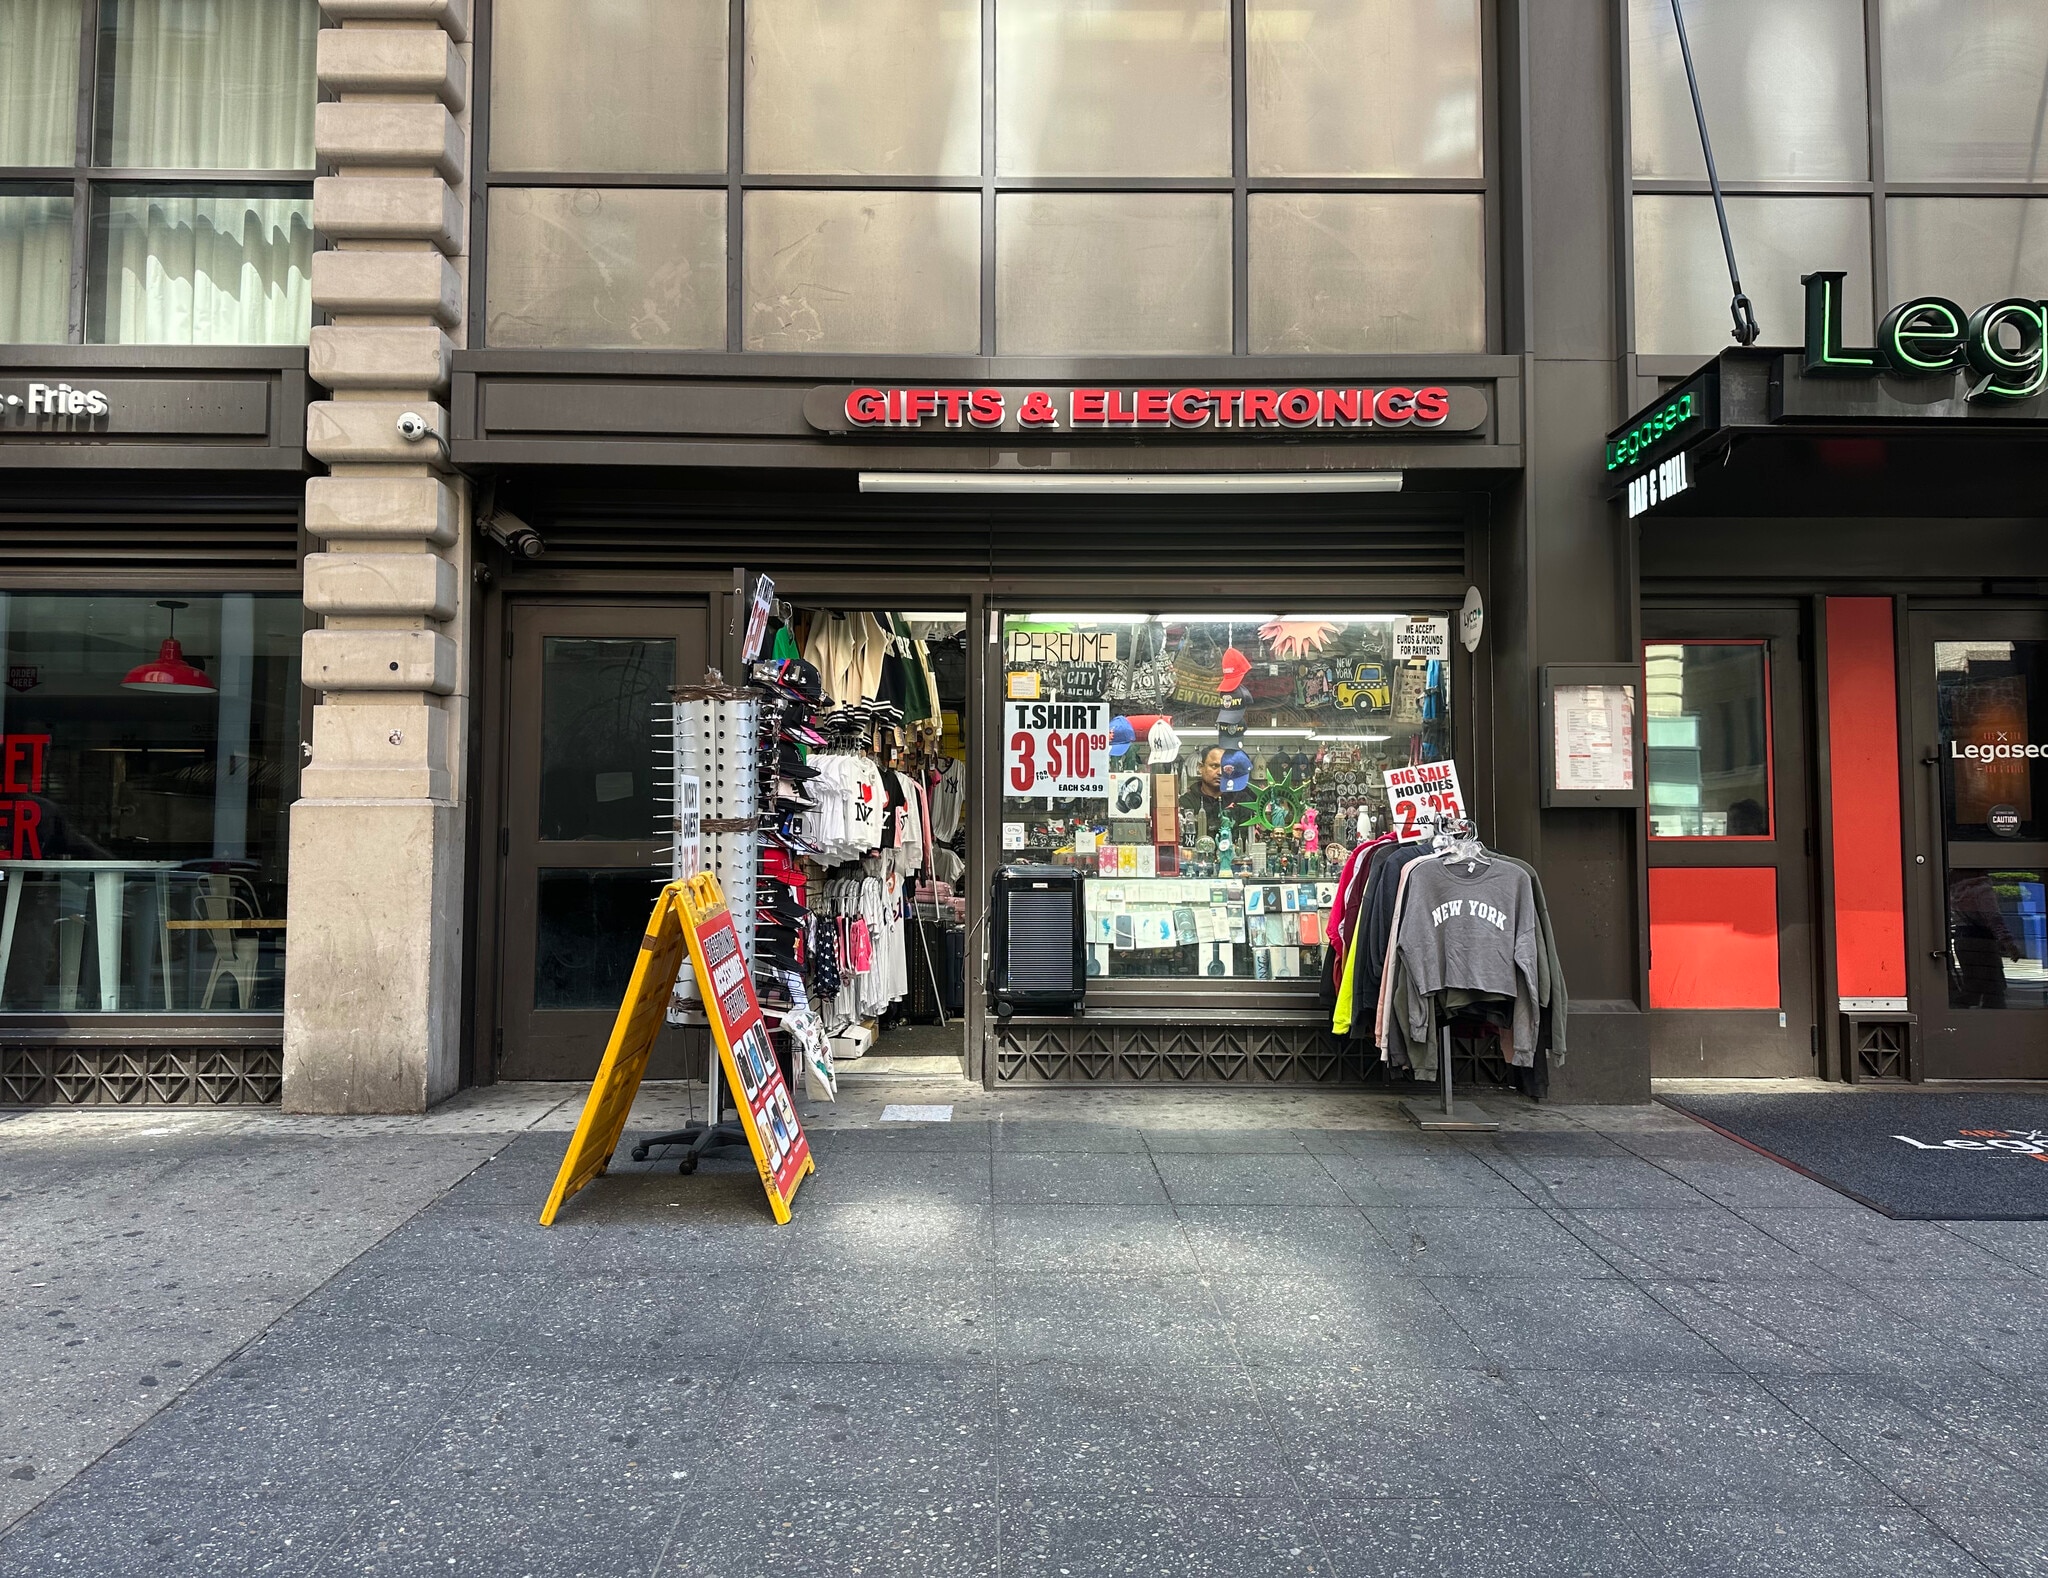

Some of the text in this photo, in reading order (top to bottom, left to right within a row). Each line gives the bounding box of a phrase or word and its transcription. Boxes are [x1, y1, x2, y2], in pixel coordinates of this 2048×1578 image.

[28, 383, 108, 416] Fries
[845, 386, 1450, 428] GIFTS & ELECTRONICS
[1605, 394, 1691, 471] Legasea
[1405, 624, 1436, 634] WE ACCEPT
[1014, 632, 1113, 662] PERFUME
[1397, 635, 1443, 645] EUROS & POUNDS
[1400, 646, 1440, 656] FOR PAYMENTS
[1336, 658, 1353, 668] NEW
[11, 668, 36, 678] ORDER
[1067, 671, 1096, 686] CITY
[1335, 668, 1353, 679] YORK
[12, 678, 34, 687] HERE
[1015, 704, 1101, 729] T.SHIRT
[1011, 731, 1036, 791] 3
[1390, 765, 1451, 786] BIG SALE
[1080, 784, 1104, 792] $4.99
[1395, 779, 1454, 798] HOODIES
[1395, 800, 1422, 839] 2
[1416, 814, 1431, 825] FOR
[1992, 815, 2018, 824] CAUTION
[1431, 899, 1508, 931] NEW YORK
